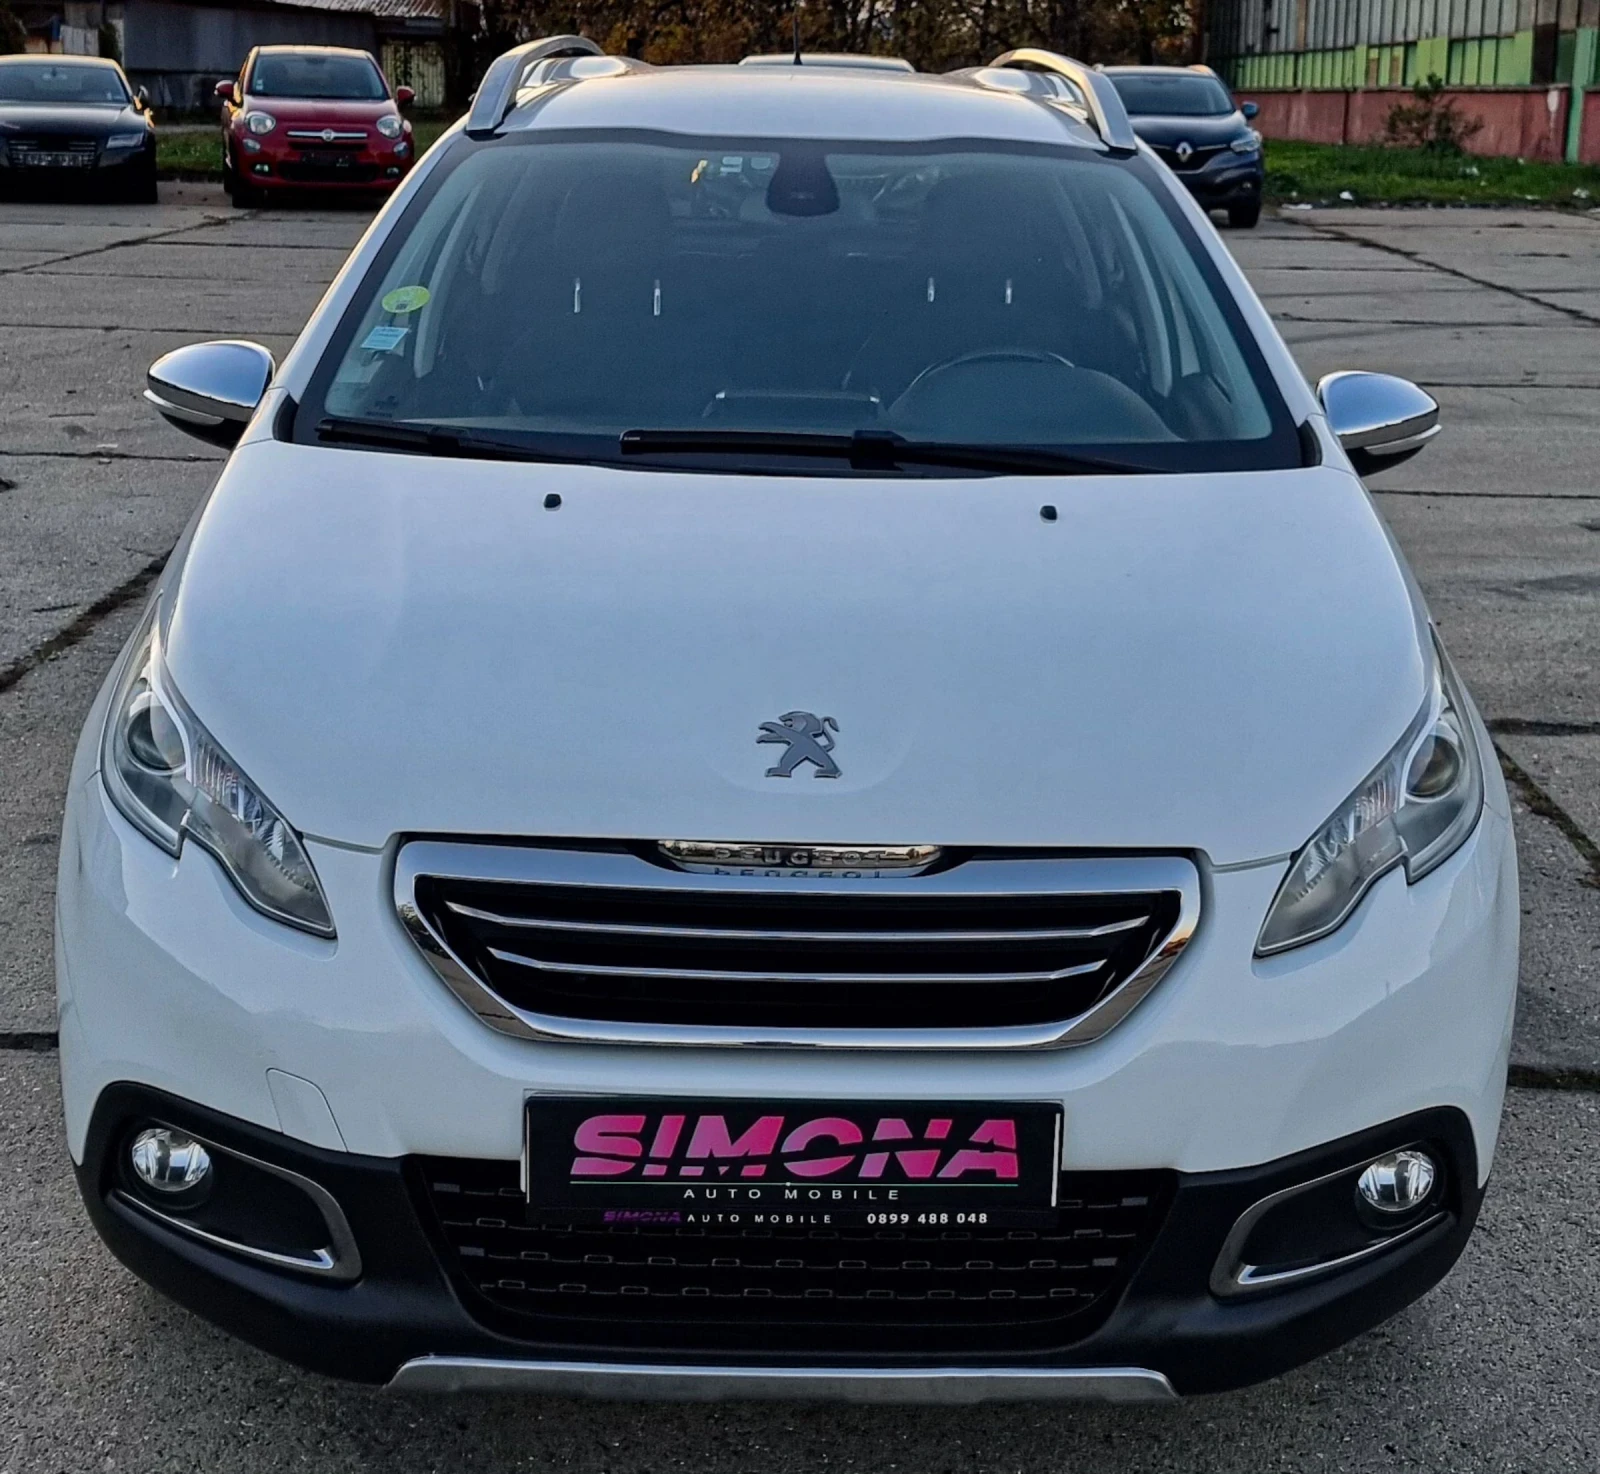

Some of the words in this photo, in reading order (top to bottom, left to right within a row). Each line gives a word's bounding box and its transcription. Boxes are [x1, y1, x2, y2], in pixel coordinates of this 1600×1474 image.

[570, 1115, 1019, 1178] SIMONA
[683, 1188, 761, 1199] AUTO
[784, 1189, 899, 1200] MOBILE
[603, 1211, 681, 1222] SIMONA
[687, 1214, 740, 1223] AUTO
[754, 1214, 831, 1223] MOBILE
[867, 1213, 910, 1224] 0899
[918, 1213, 949, 1224] 488
[956, 1213, 988, 1224] 048
